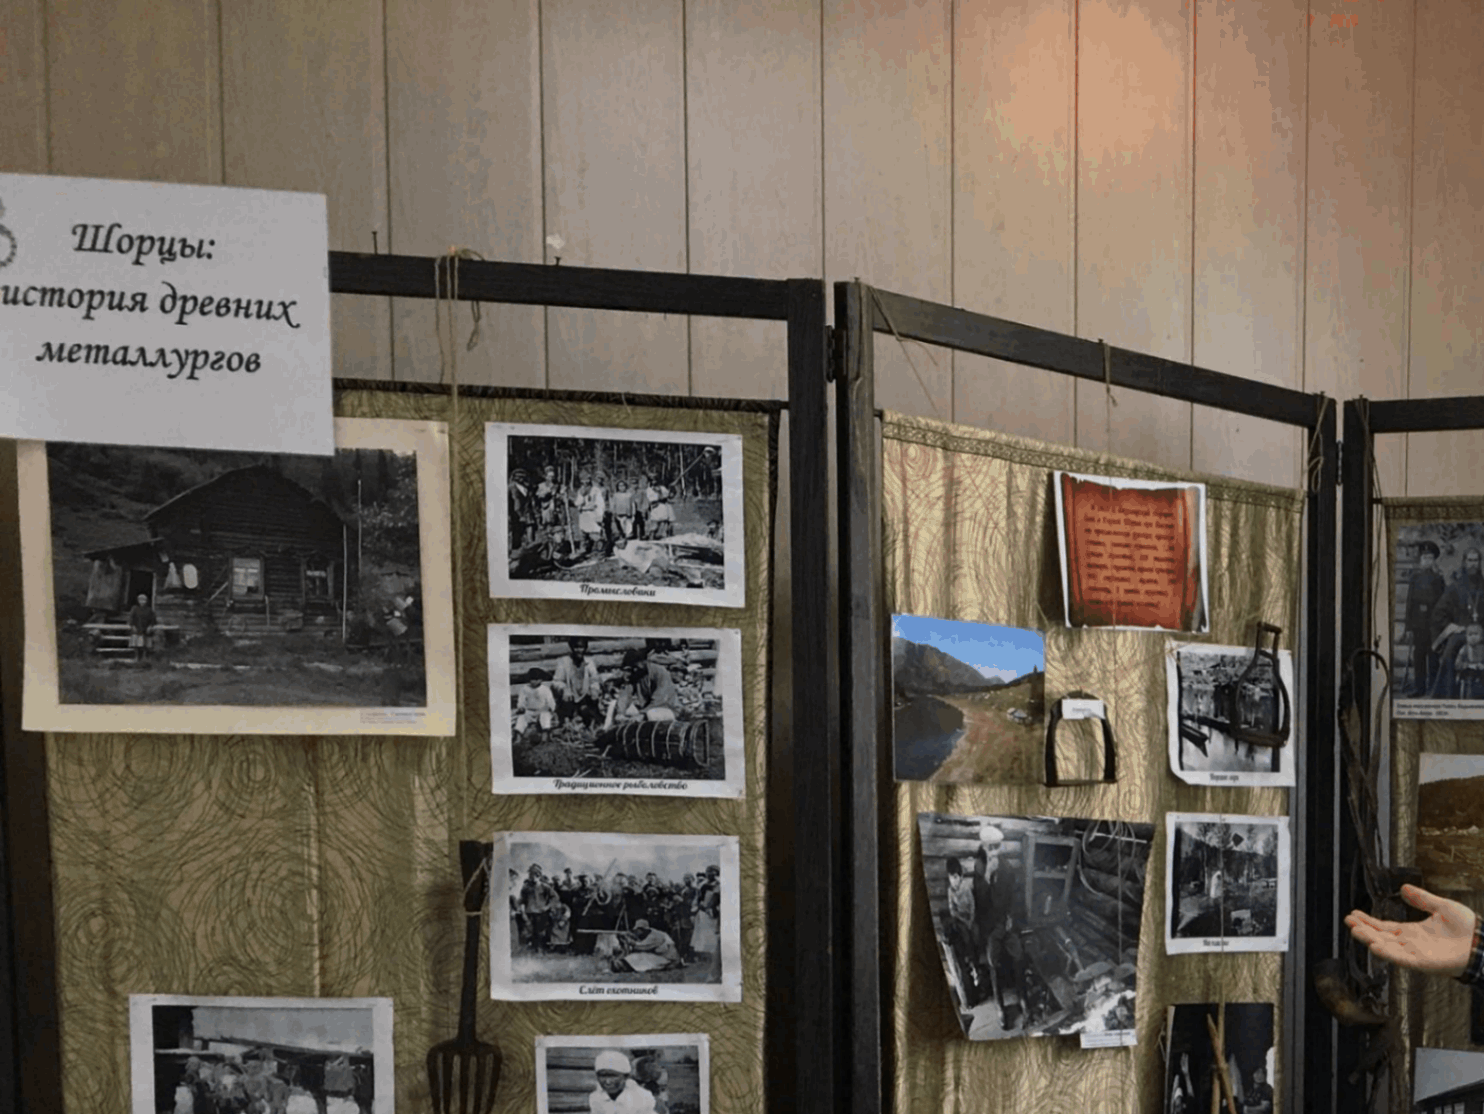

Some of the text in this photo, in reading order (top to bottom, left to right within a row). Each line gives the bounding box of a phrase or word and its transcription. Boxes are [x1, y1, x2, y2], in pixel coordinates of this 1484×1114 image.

[72, 224, 216, 265] Шорцы:
[1, 281, 301, 328] история древних
[35, 340, 262, 379] металлургов
[553, 779, 688, 791] Традиционное рыболовство
[606, 985, 659, 995] охотников
